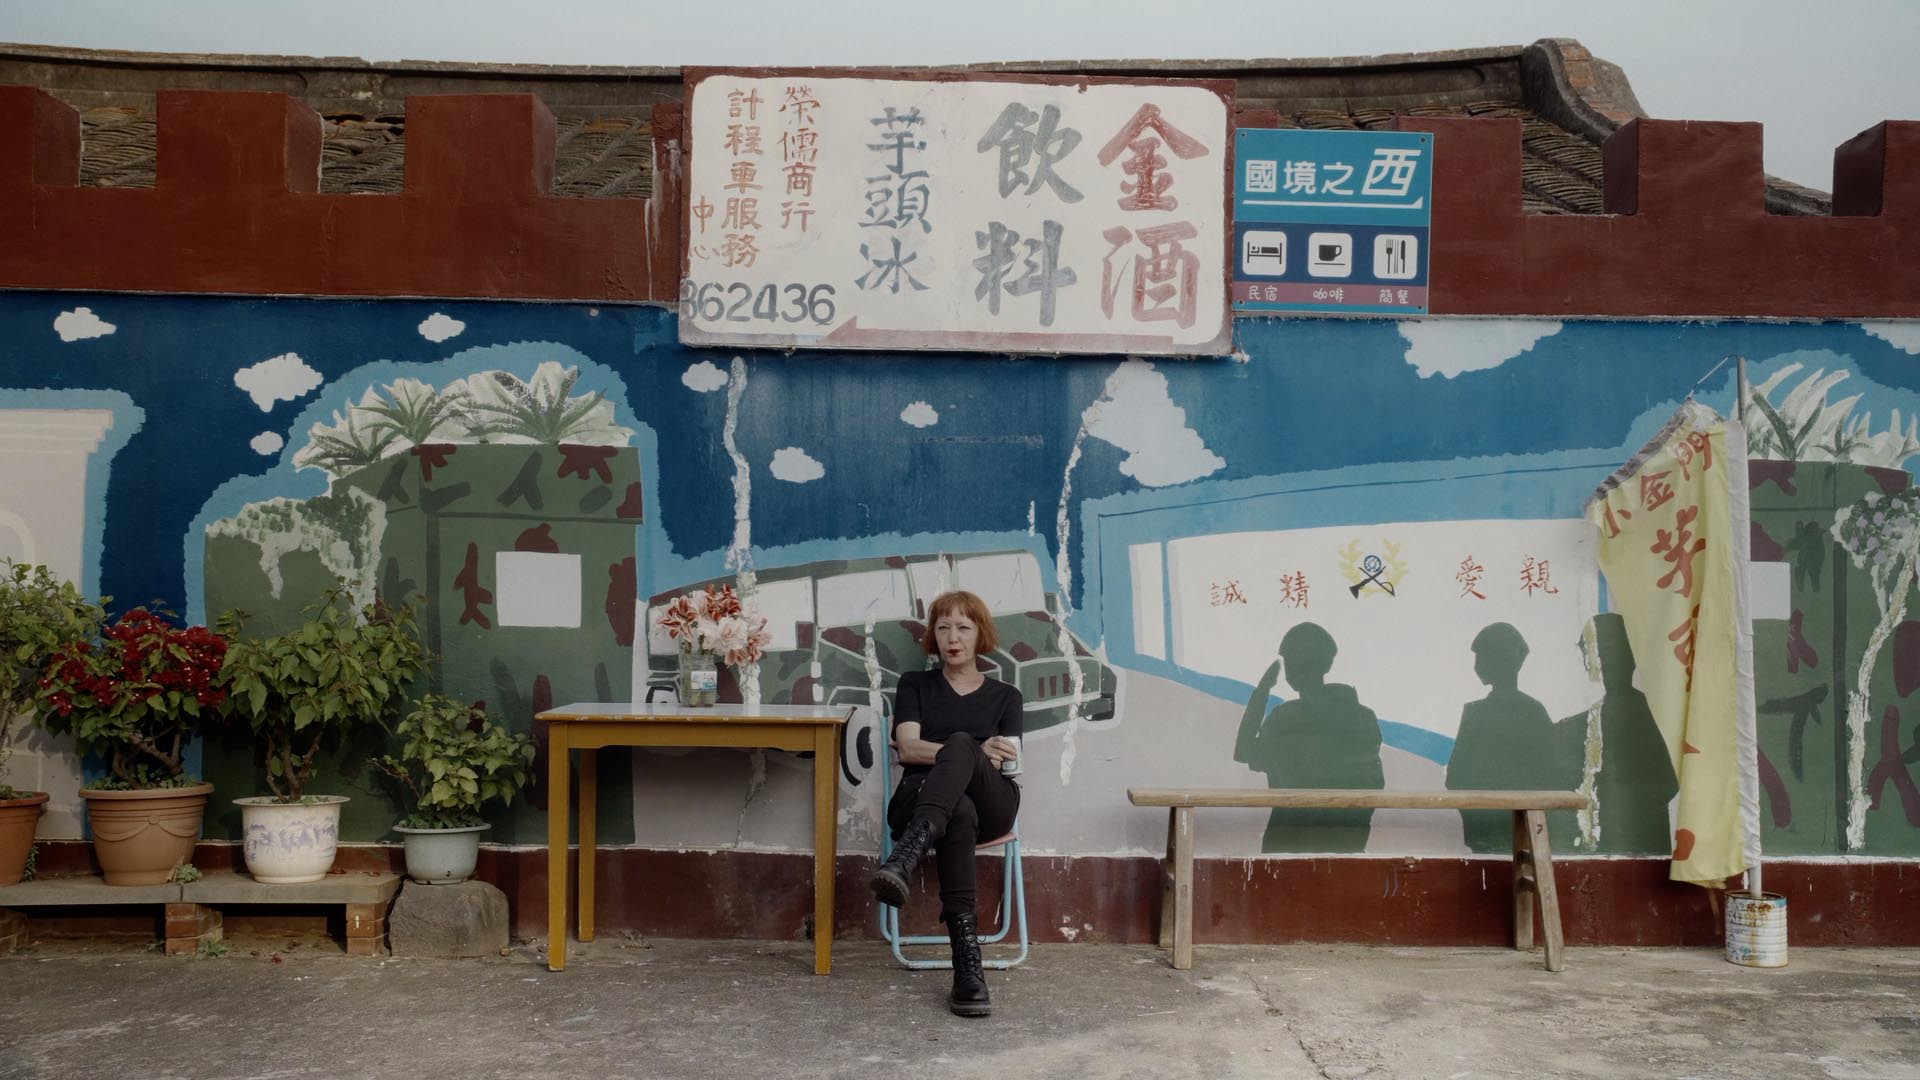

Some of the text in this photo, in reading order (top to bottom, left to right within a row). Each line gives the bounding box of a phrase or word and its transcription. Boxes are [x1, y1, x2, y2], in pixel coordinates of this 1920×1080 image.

[720, 87, 764, 268] 計程車服務
[854, 106, 932, 294] 芋頭冰
[972, 101, 1085, 327] 飲料
[1097, 102, 1210, 329] 金酒
[1245, 148, 1421, 197] 國境之西
[1249, 285, 1409, 305] 民宿 咖啡 簡餐
